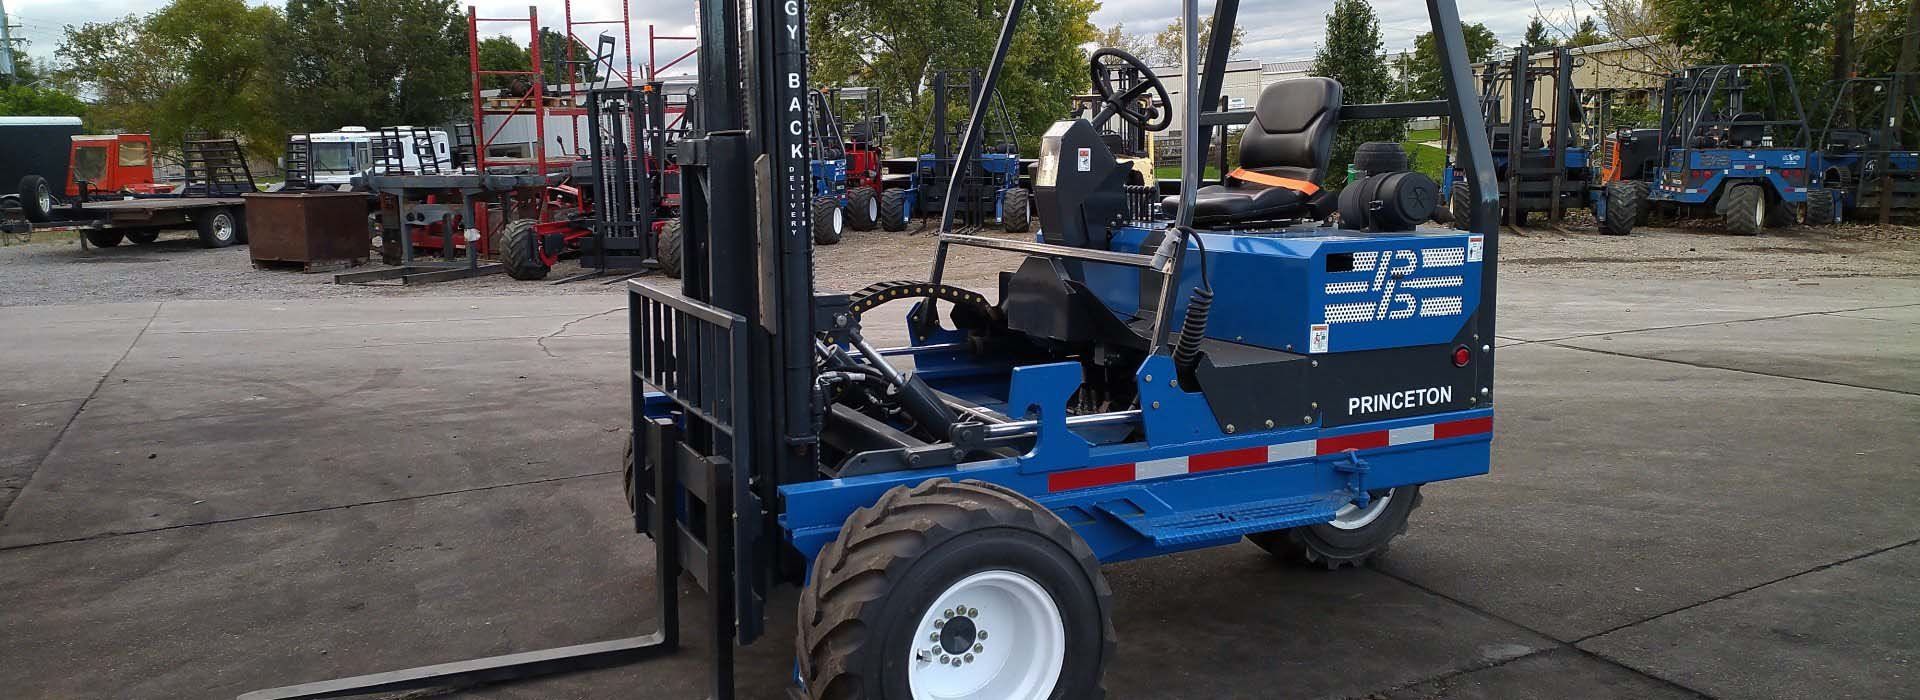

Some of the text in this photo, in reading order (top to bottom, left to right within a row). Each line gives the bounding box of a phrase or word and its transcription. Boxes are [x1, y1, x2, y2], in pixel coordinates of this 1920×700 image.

[788, 72, 803, 159] BACK
[788, 166, 797, 236] DELIVERY
[1348, 385, 1452, 416] PRINCETON
